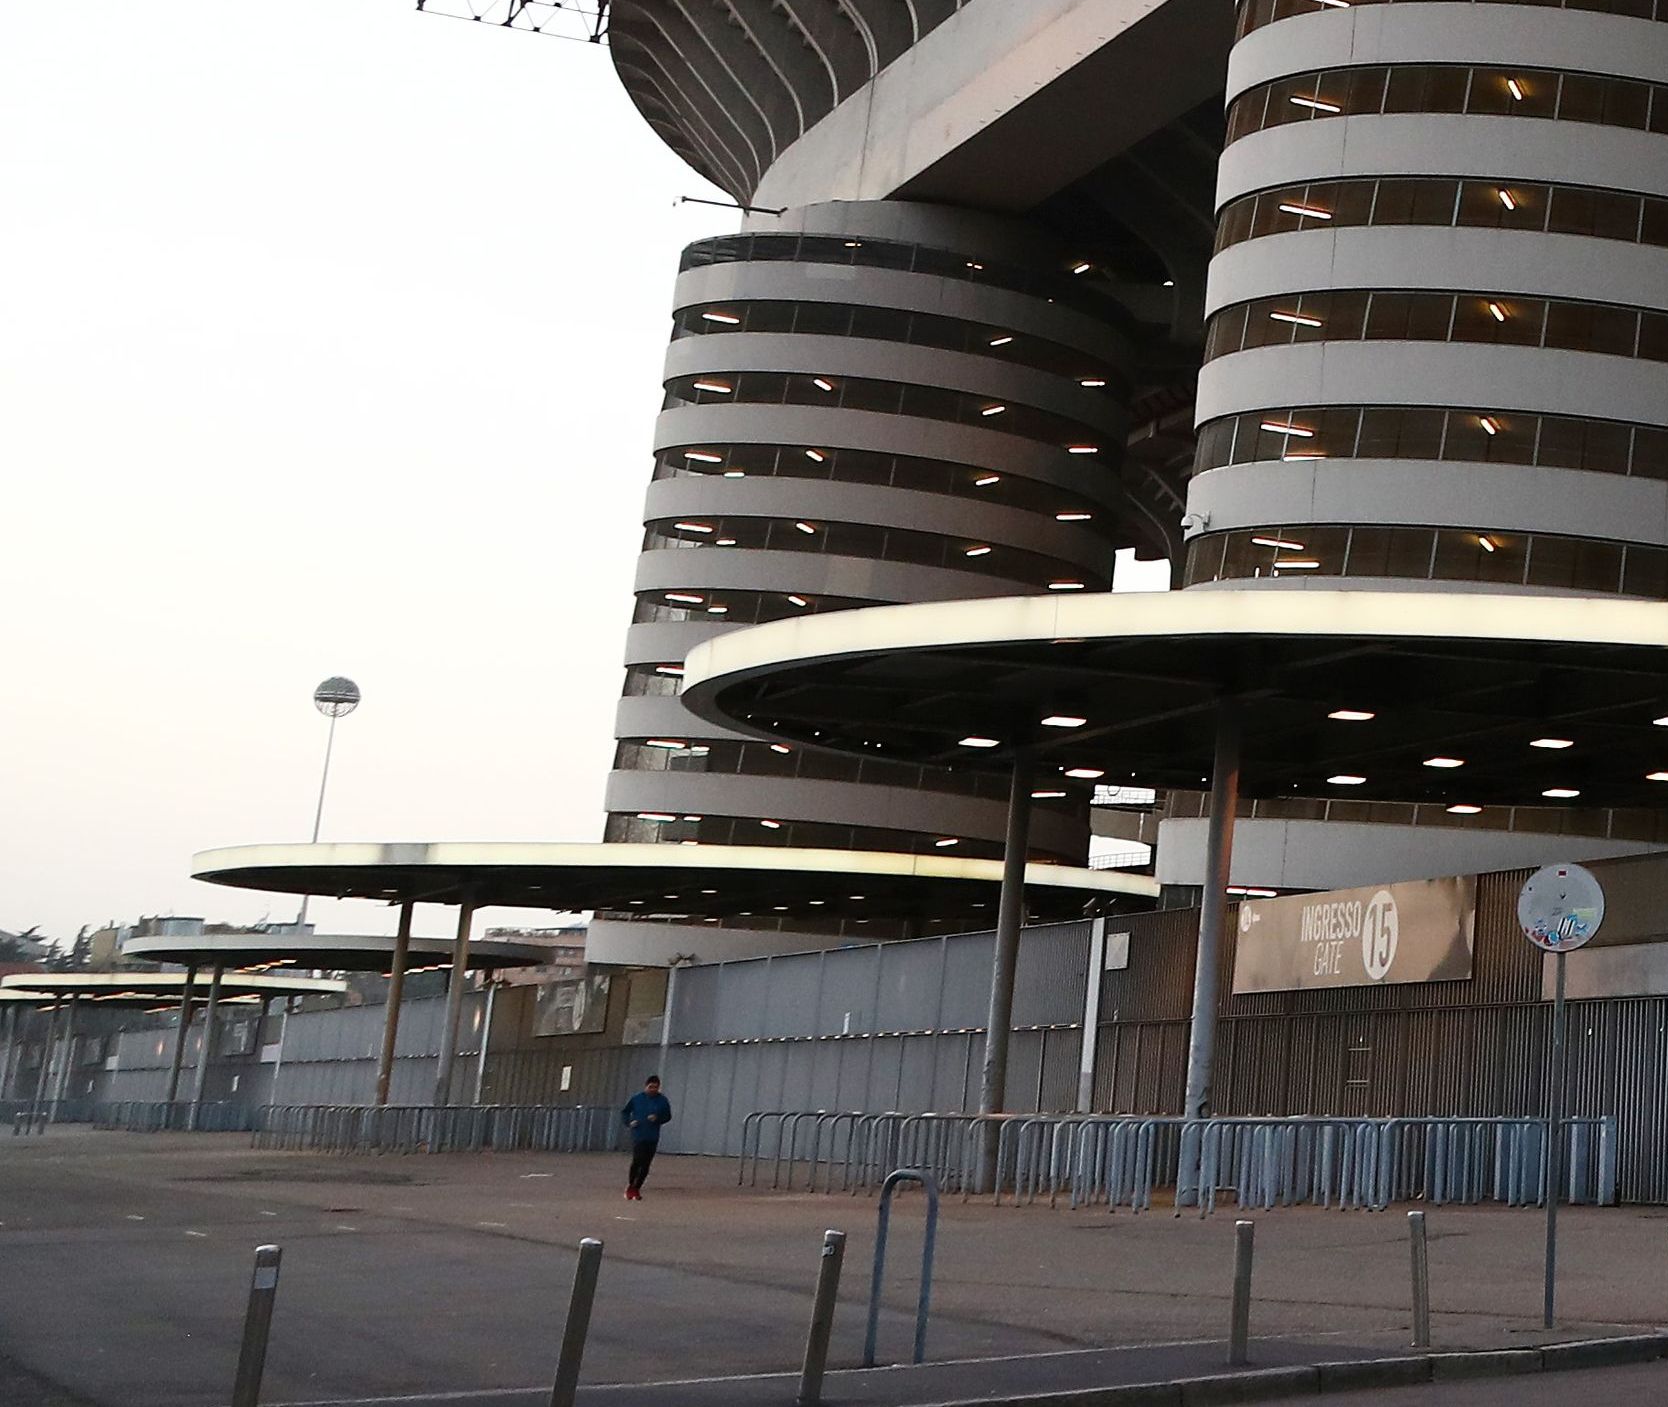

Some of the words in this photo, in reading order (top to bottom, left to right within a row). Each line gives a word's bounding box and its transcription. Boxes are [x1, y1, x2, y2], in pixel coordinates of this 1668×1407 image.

[1301, 900, 1361, 942] INGRESSO
[1367, 902, 1393, 968] 15
[1313, 941, 1345, 976] GATE
